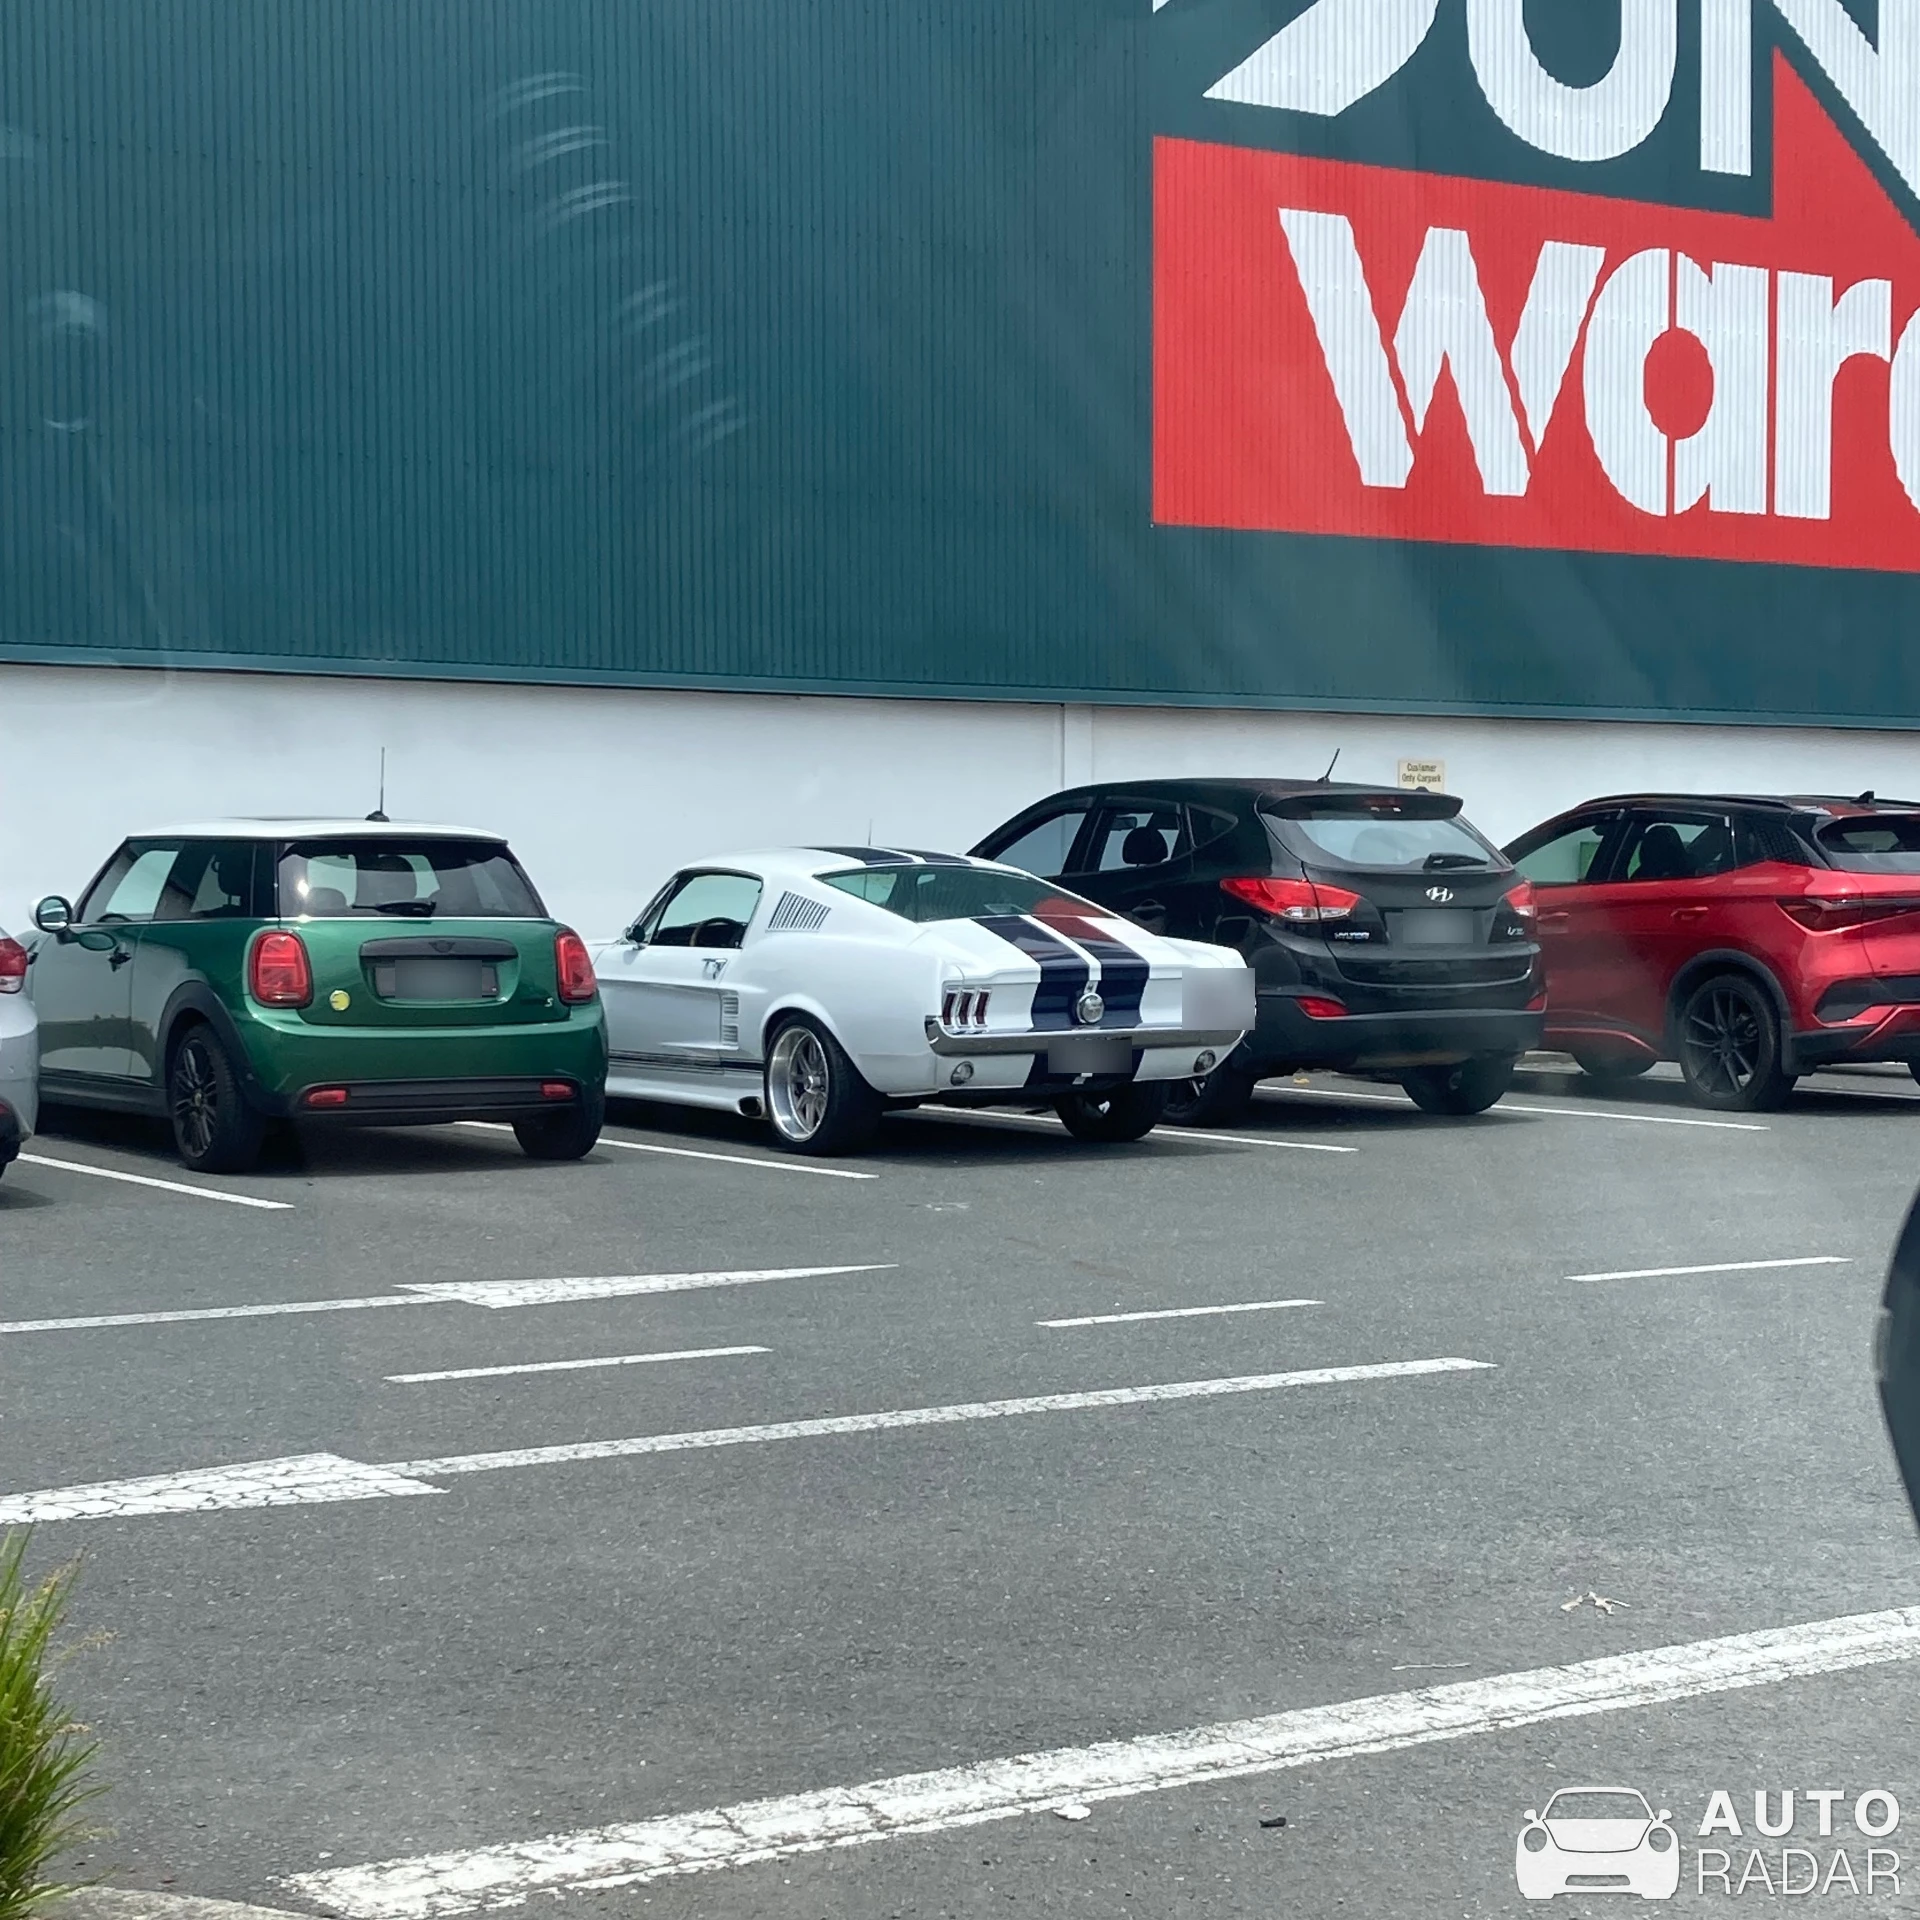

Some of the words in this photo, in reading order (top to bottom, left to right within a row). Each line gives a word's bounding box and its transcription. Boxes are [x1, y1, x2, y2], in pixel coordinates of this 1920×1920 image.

[1278, 206, 1920, 520] war
[1407, 762, 1437, 772] Customer
[1402, 773, 1415, 783] Only
[1417, 773, 1441, 783] Carpark
